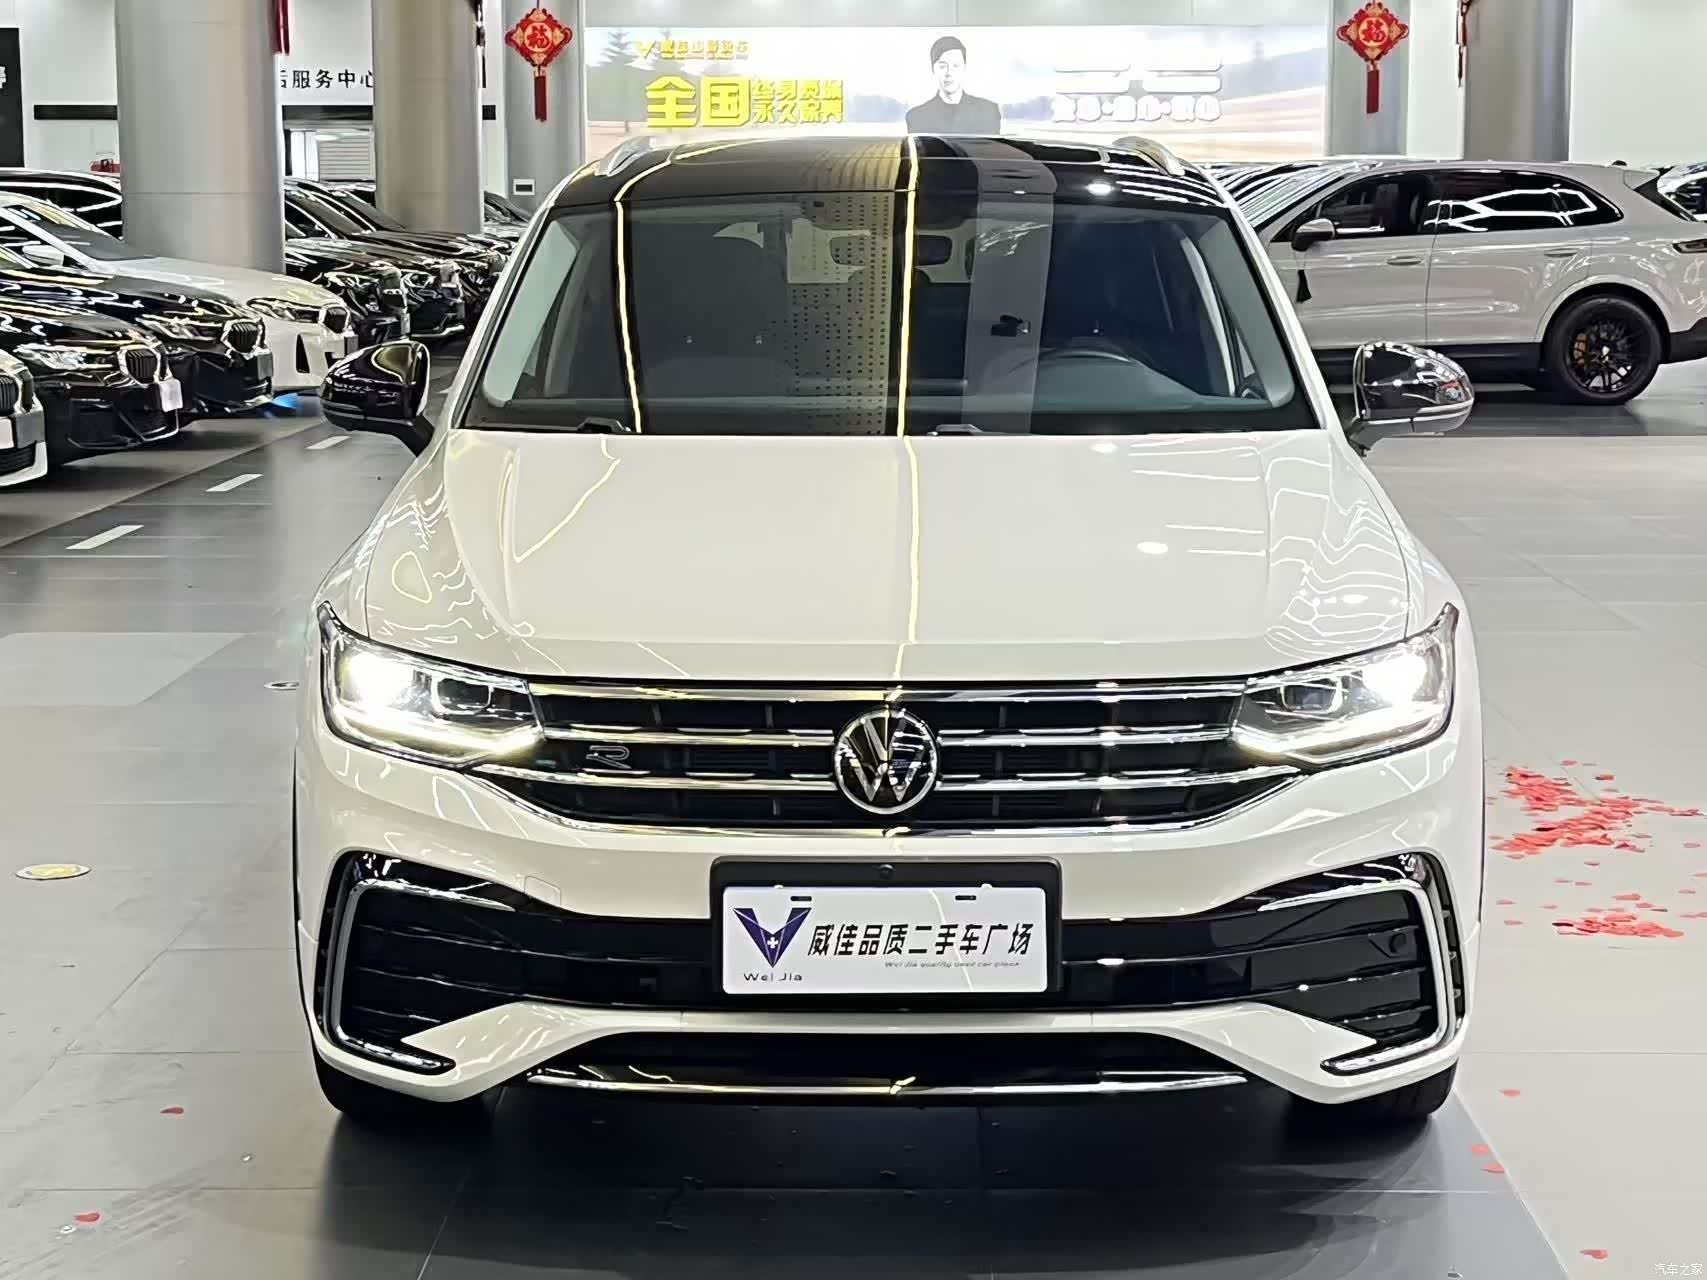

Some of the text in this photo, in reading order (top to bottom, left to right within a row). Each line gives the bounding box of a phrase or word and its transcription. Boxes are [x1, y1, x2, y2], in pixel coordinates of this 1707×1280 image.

[645, 75, 752, 127] 全国
[808, 923, 1034, 956] 威佳品质二手车广场
[743, 972, 803, 982] Wei Jia
